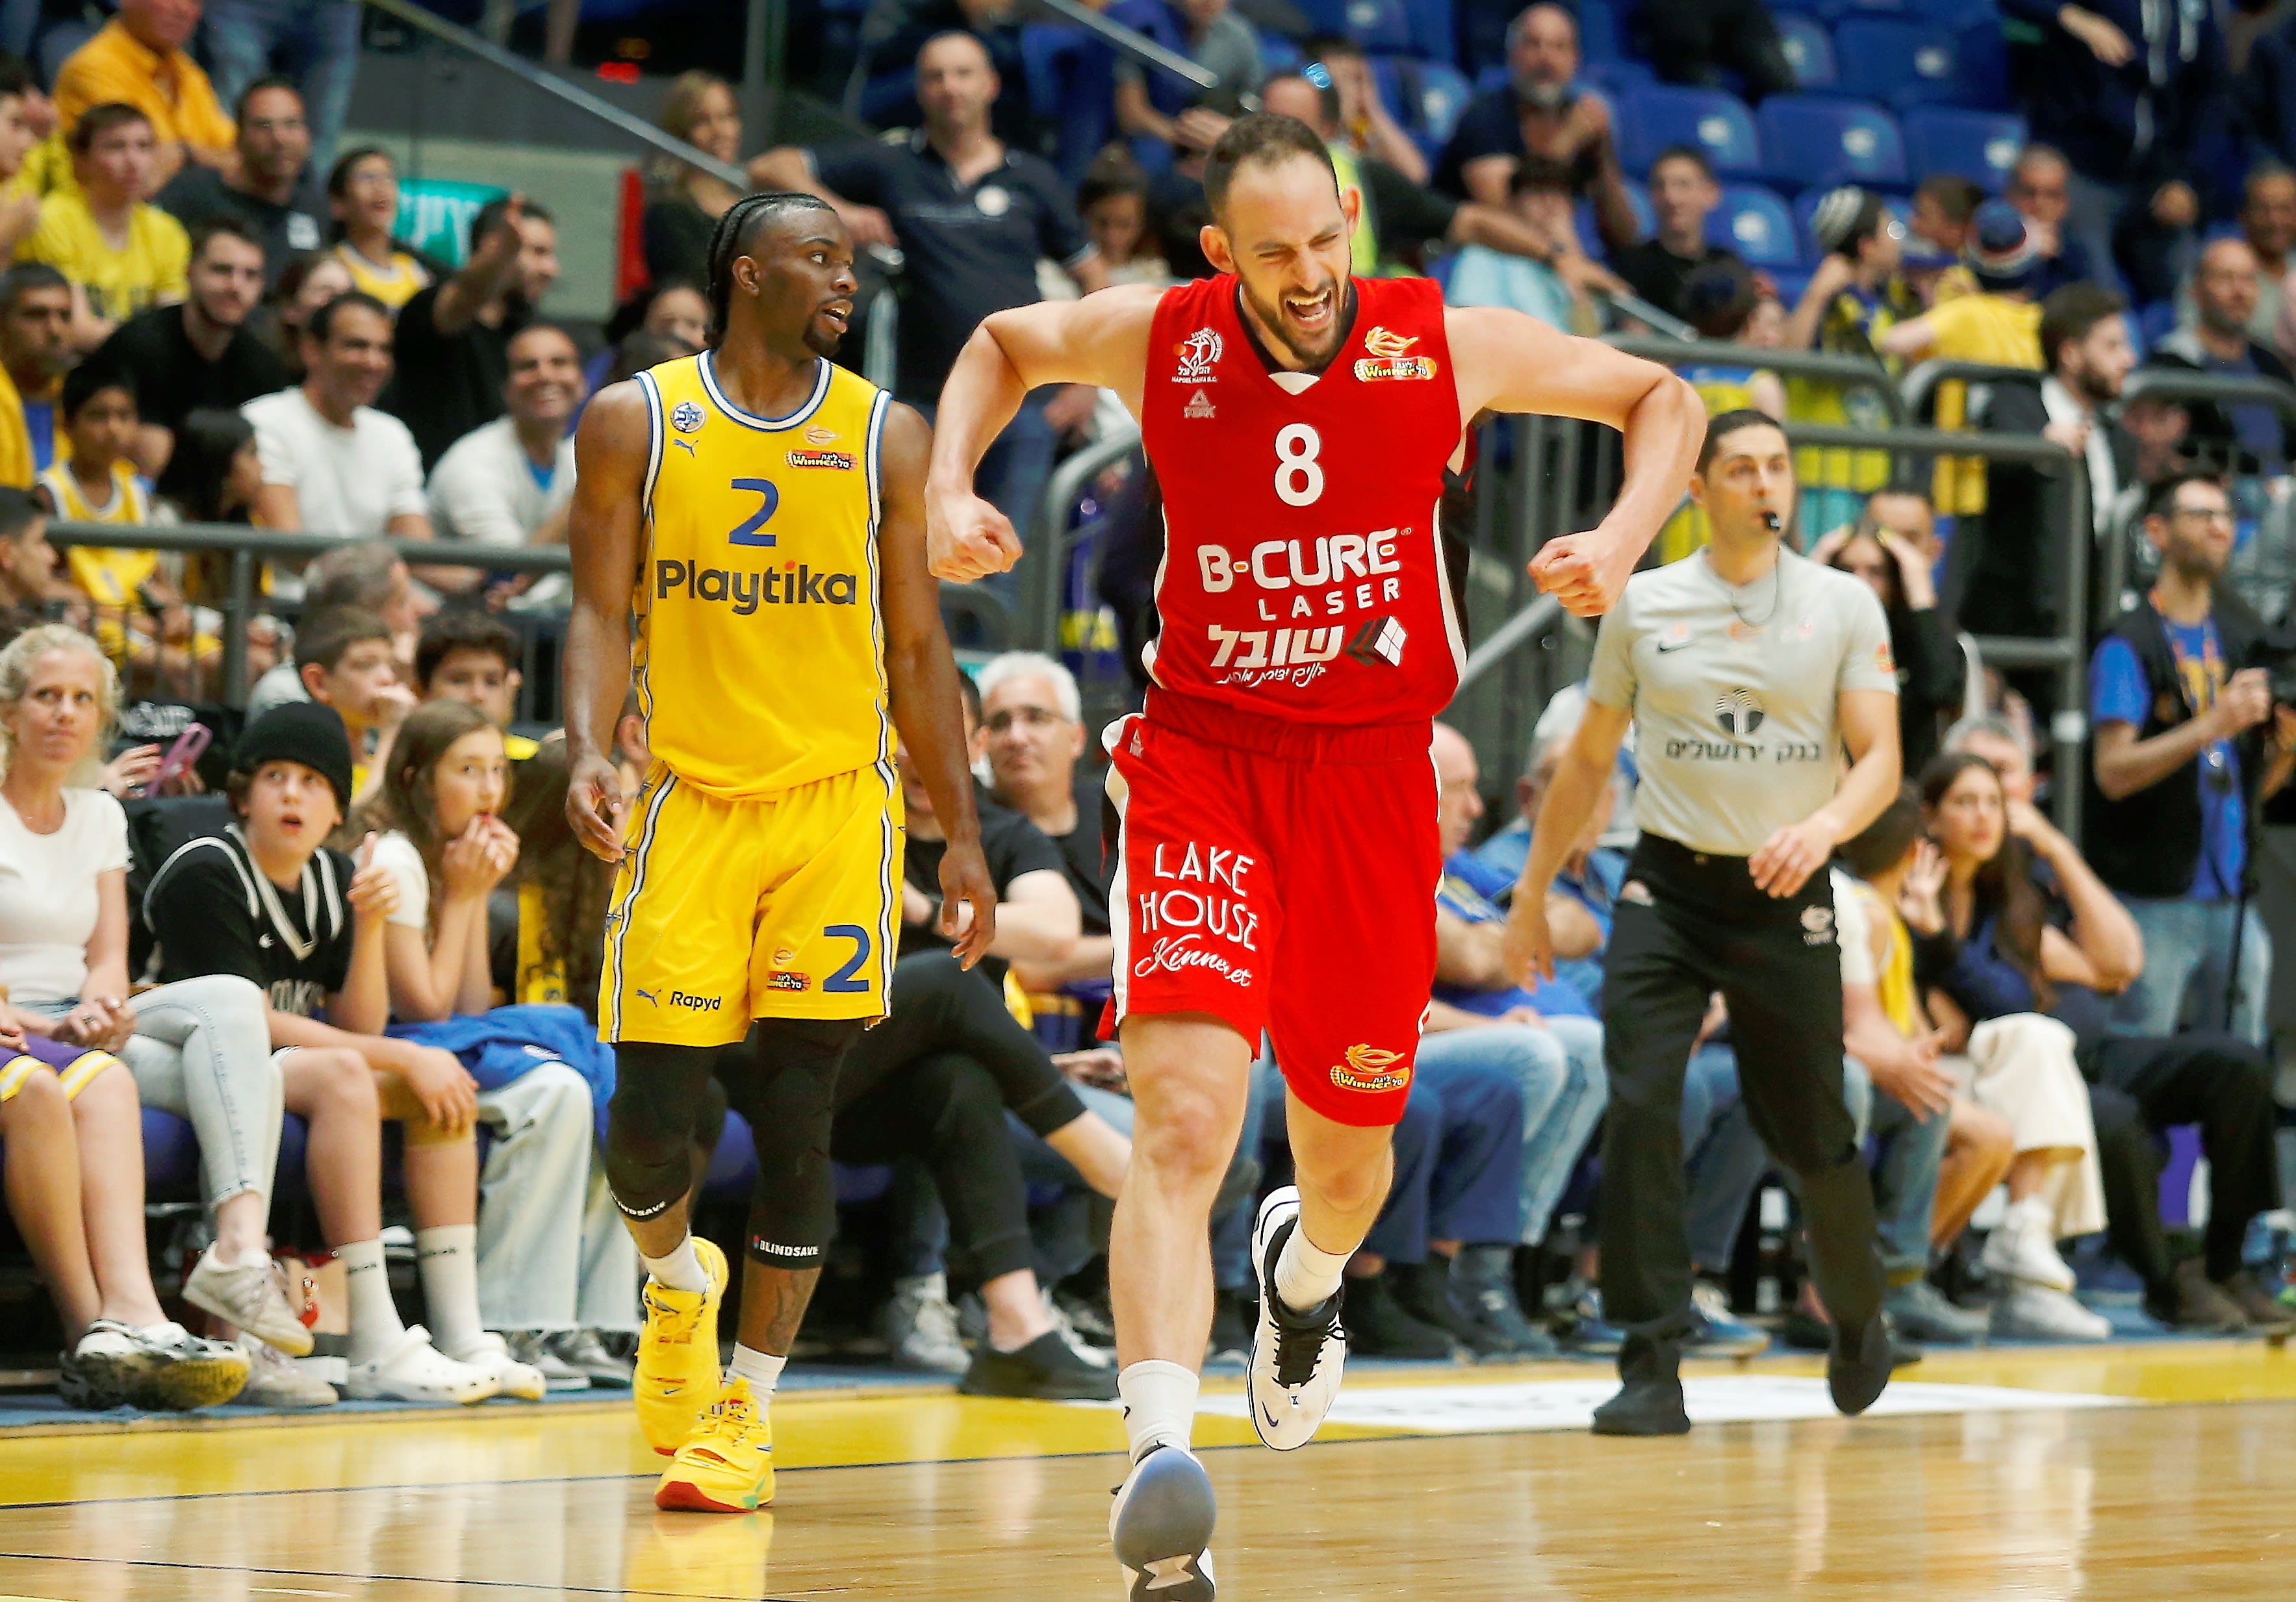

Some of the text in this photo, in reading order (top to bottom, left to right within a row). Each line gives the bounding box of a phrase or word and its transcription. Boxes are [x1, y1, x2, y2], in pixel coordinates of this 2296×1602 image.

[1364, 364, 1416, 377] Winner
[792, 453, 837, 466] Winner
[1273, 422, 1325, 507] 8
[728, 477, 780, 547] 2
[1197, 527, 1401, 592] B-CURE
[656, 559, 856, 615] Playtika
[1258, 577, 1401, 621] LASER
[1207, 624, 1346, 668] שובל
[1665, 739, 1820, 765] בנק ירושלים
[1154, 841, 1255, 898] LAKE
[1139, 889, 1258, 952] HOUSE
[822, 924, 871, 993] 2
[1134, 933, 1253, 987] Kinneret
[669, 991, 722, 1011] Rapyd
[1339, 1073, 1392, 1089] Winner
[759, 1240, 820, 1257] BLINDSAVE
